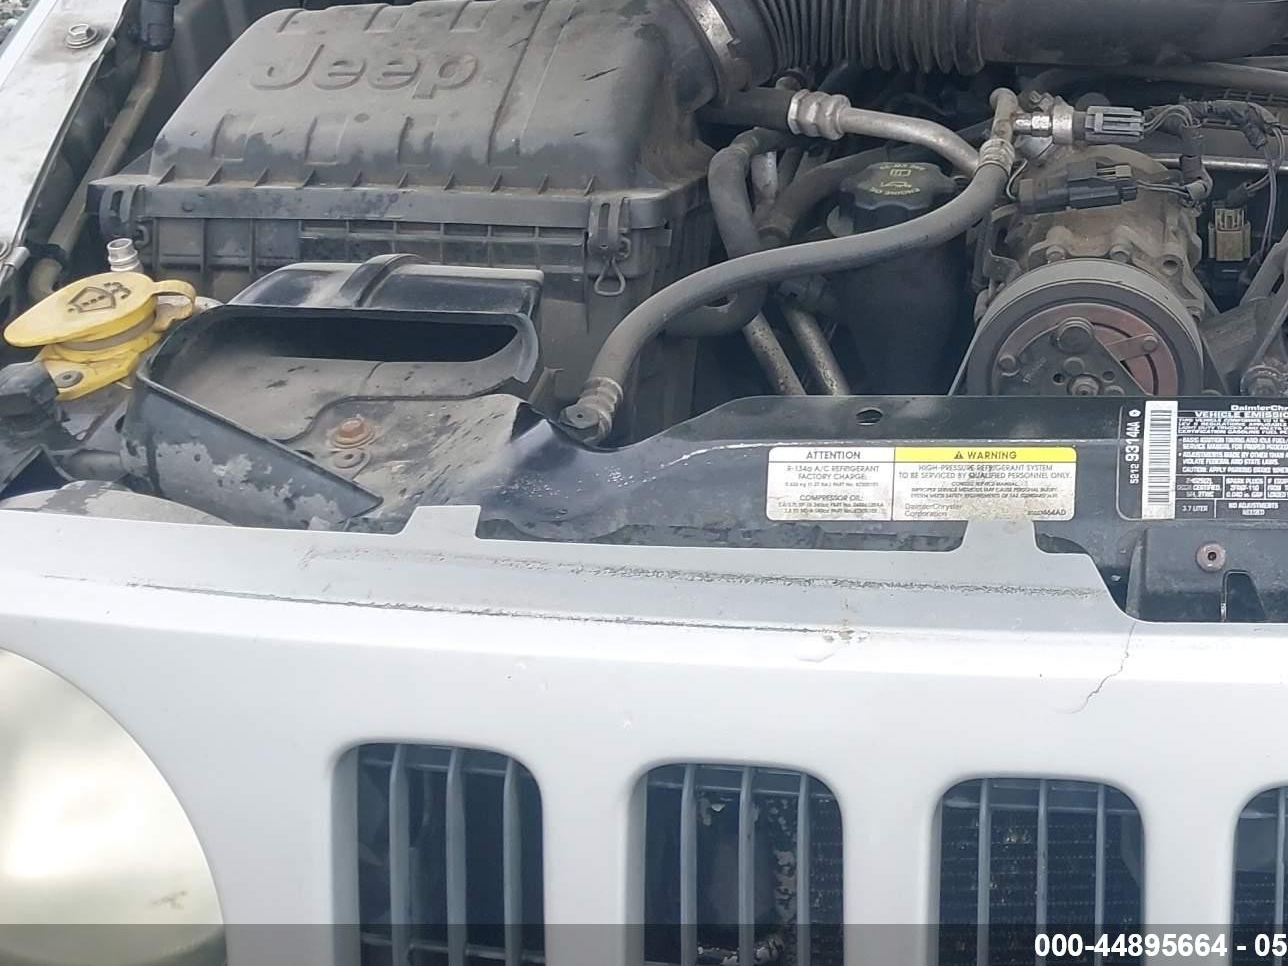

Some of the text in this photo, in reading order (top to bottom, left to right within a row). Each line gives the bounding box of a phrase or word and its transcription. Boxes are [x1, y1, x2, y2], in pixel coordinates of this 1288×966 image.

[250, 43, 479, 100] Jeep
[1194, 411, 1243, 419] VEHICLE
[806, 450, 861, 460] ATTENTION
[967, 451, 1017, 460] WARNING
[904, 510, 948, 519] Corporation
